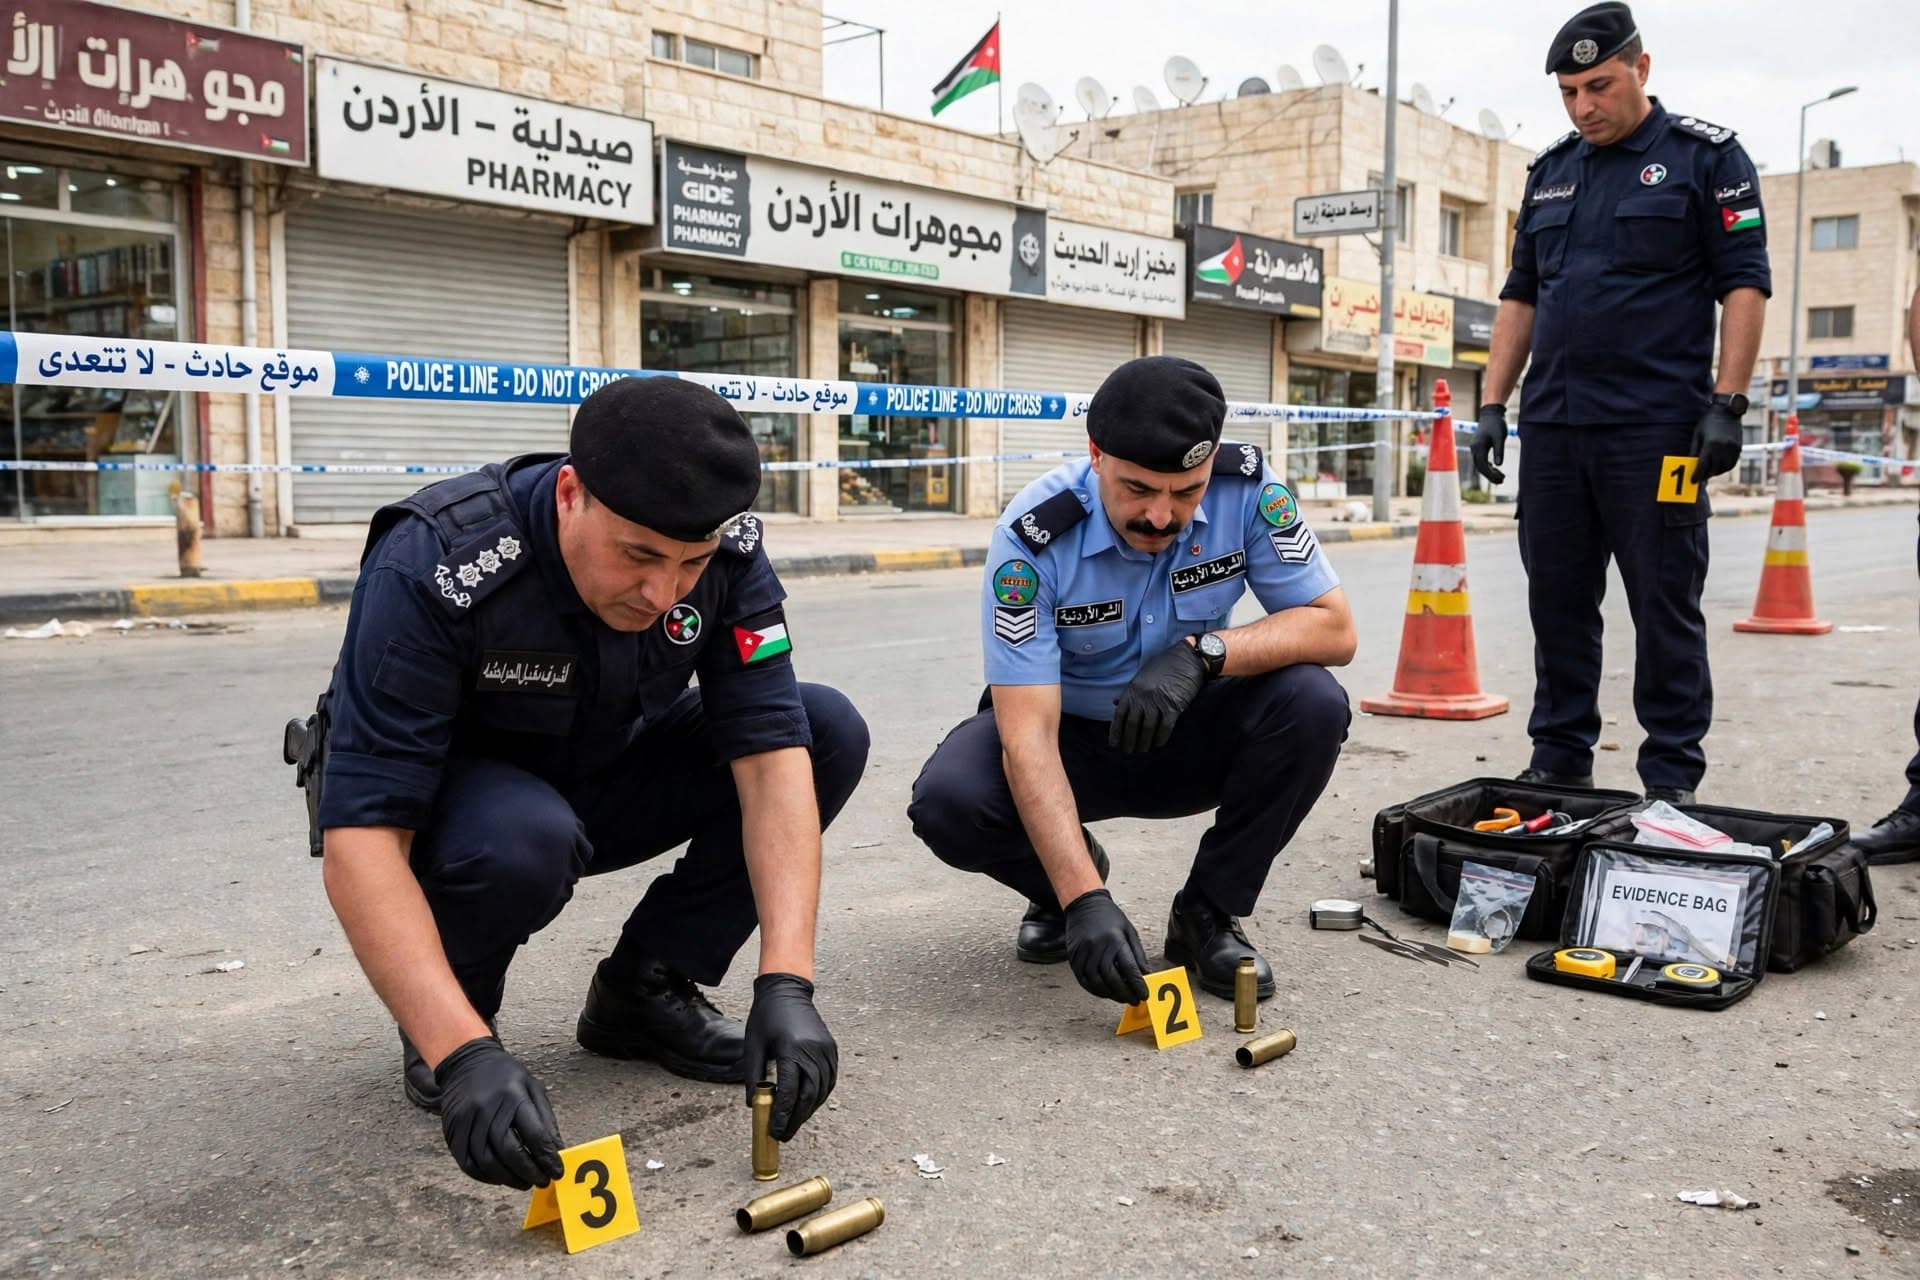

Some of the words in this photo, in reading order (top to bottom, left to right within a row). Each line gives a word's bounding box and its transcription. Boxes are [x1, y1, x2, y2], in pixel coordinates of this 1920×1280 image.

[0, 11, 56, 87] الأ
[343, 83, 459, 139] الأردن
[512, 106, 633, 170] صيدلية
[467, 158, 632, 208] PHARMACY
[681, 181, 735, 206] GIDE
[673, 204, 742, 229] PHARMACY
[767, 180, 861, 238] الأردن
[673, 225, 742, 248] PHARMACY
[872, 201, 1002, 260] مجوهرات
[1054, 231, 1109, 269] الحديث
[1114, 245, 1140, 281] إربد
[1143, 249, 1176, 281] مخبز
[39, 347, 127, 378] تتعدى
[137, 348, 155, 375] لا
[185, 350, 252, 378] حادث
[260, 353, 319, 392] موقع
[386, 359, 454, 393] POLICE
[459, 364, 499, 395] LINE
[513, 367, 538, 397] DO
[541, 368, 575, 398] NOT
[579, 371, 632, 399] CRO
[747, 380, 757, 401] لا
[772, 382, 810, 402] حادث
[812, 390, 848, 412] موقع
[885, 387, 930, 411] POLICE
[932, 390, 957, 413] LINE
[966, 393, 981, 415] DO
[984, 394, 1006, 416] NOT
[1008, 395, 1043, 417] CROSS
[1670, 464, 1686, 495] 1
[1173, 566, 1209, 588] الأردنية
[1209, 554, 1243, 575] الشرطة
[1060, 605, 1099, 624] الأردنية
[1612, 885, 1688, 907] EVIDENCE
[1692, 895, 1728, 913] BAG
[1165, 982, 1190, 1034] 2
[574, 1159, 618, 1229] 3
